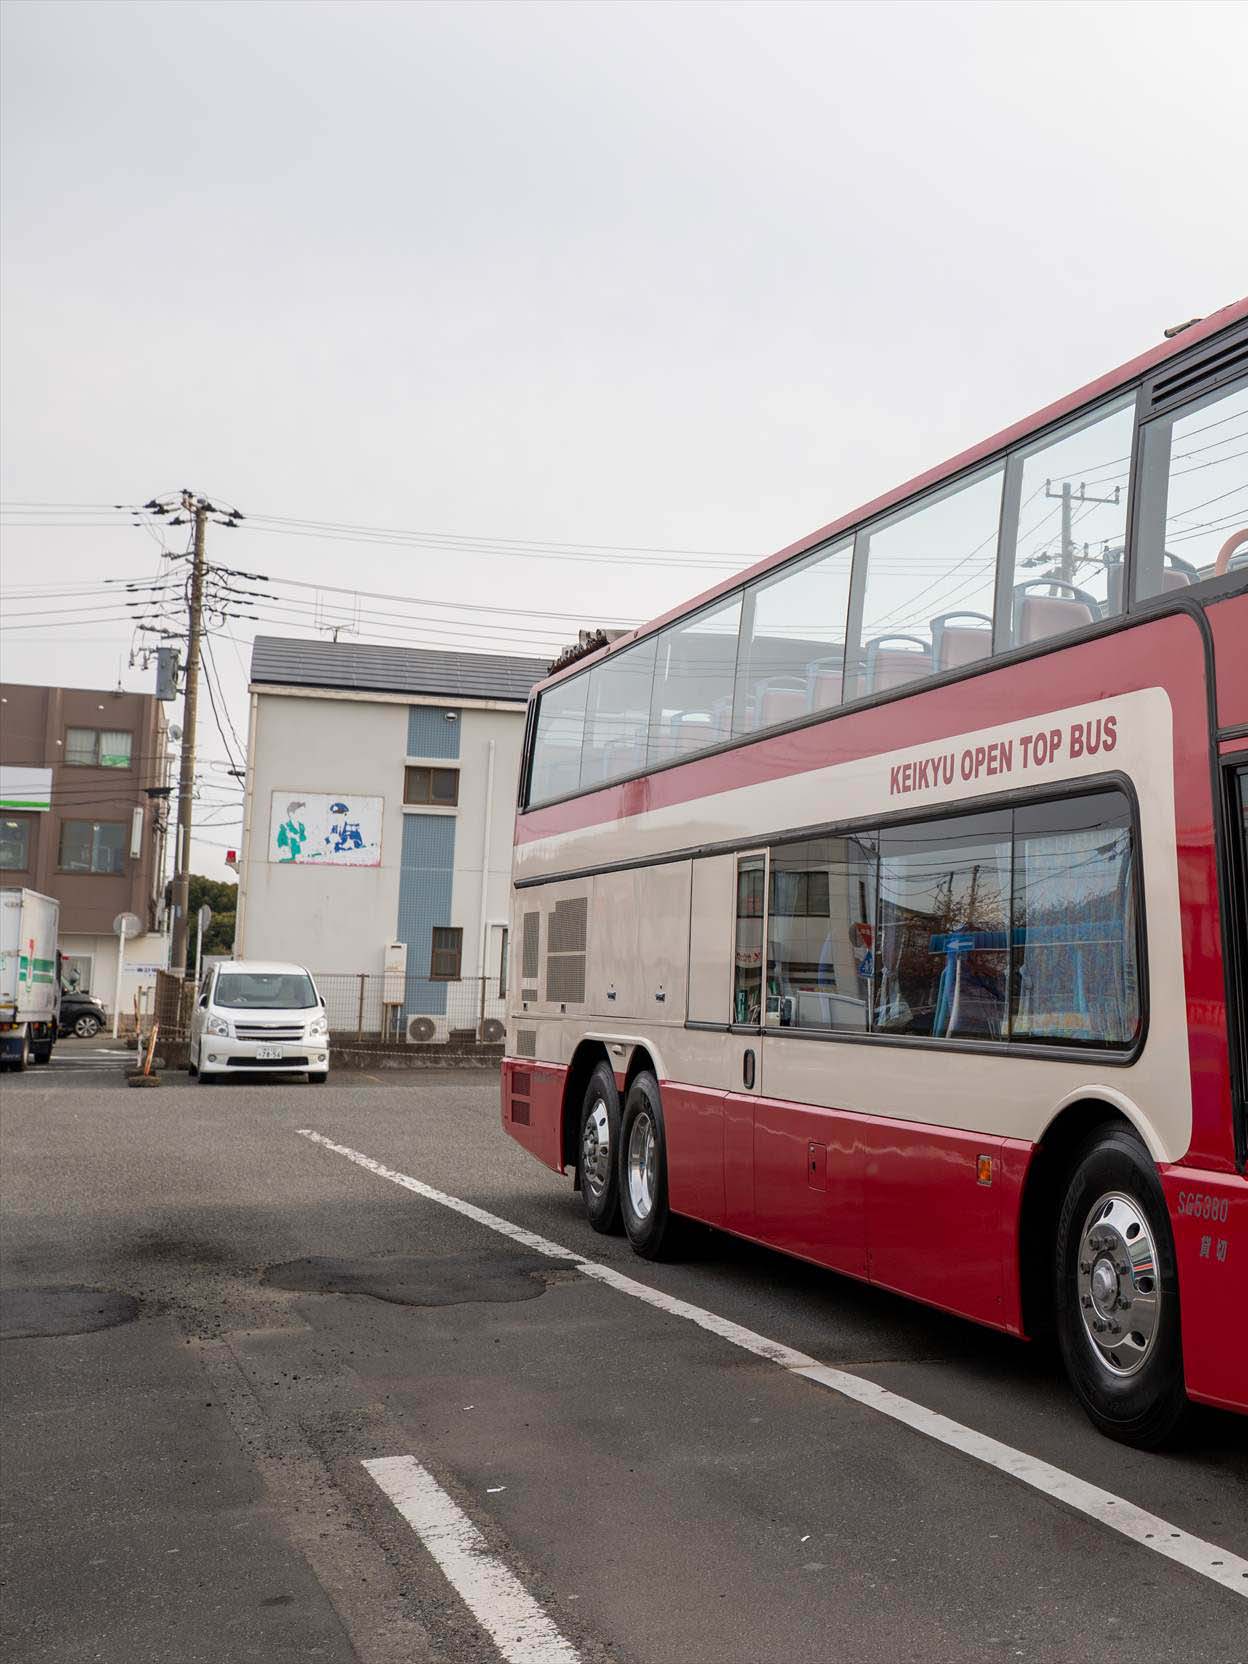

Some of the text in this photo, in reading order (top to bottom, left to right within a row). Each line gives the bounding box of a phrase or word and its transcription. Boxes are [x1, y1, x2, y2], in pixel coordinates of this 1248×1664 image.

[890, 715, 1118, 795] KEIKYU OPEN TOP BUS
[1178, 1191, 1229, 1223] SG5380
